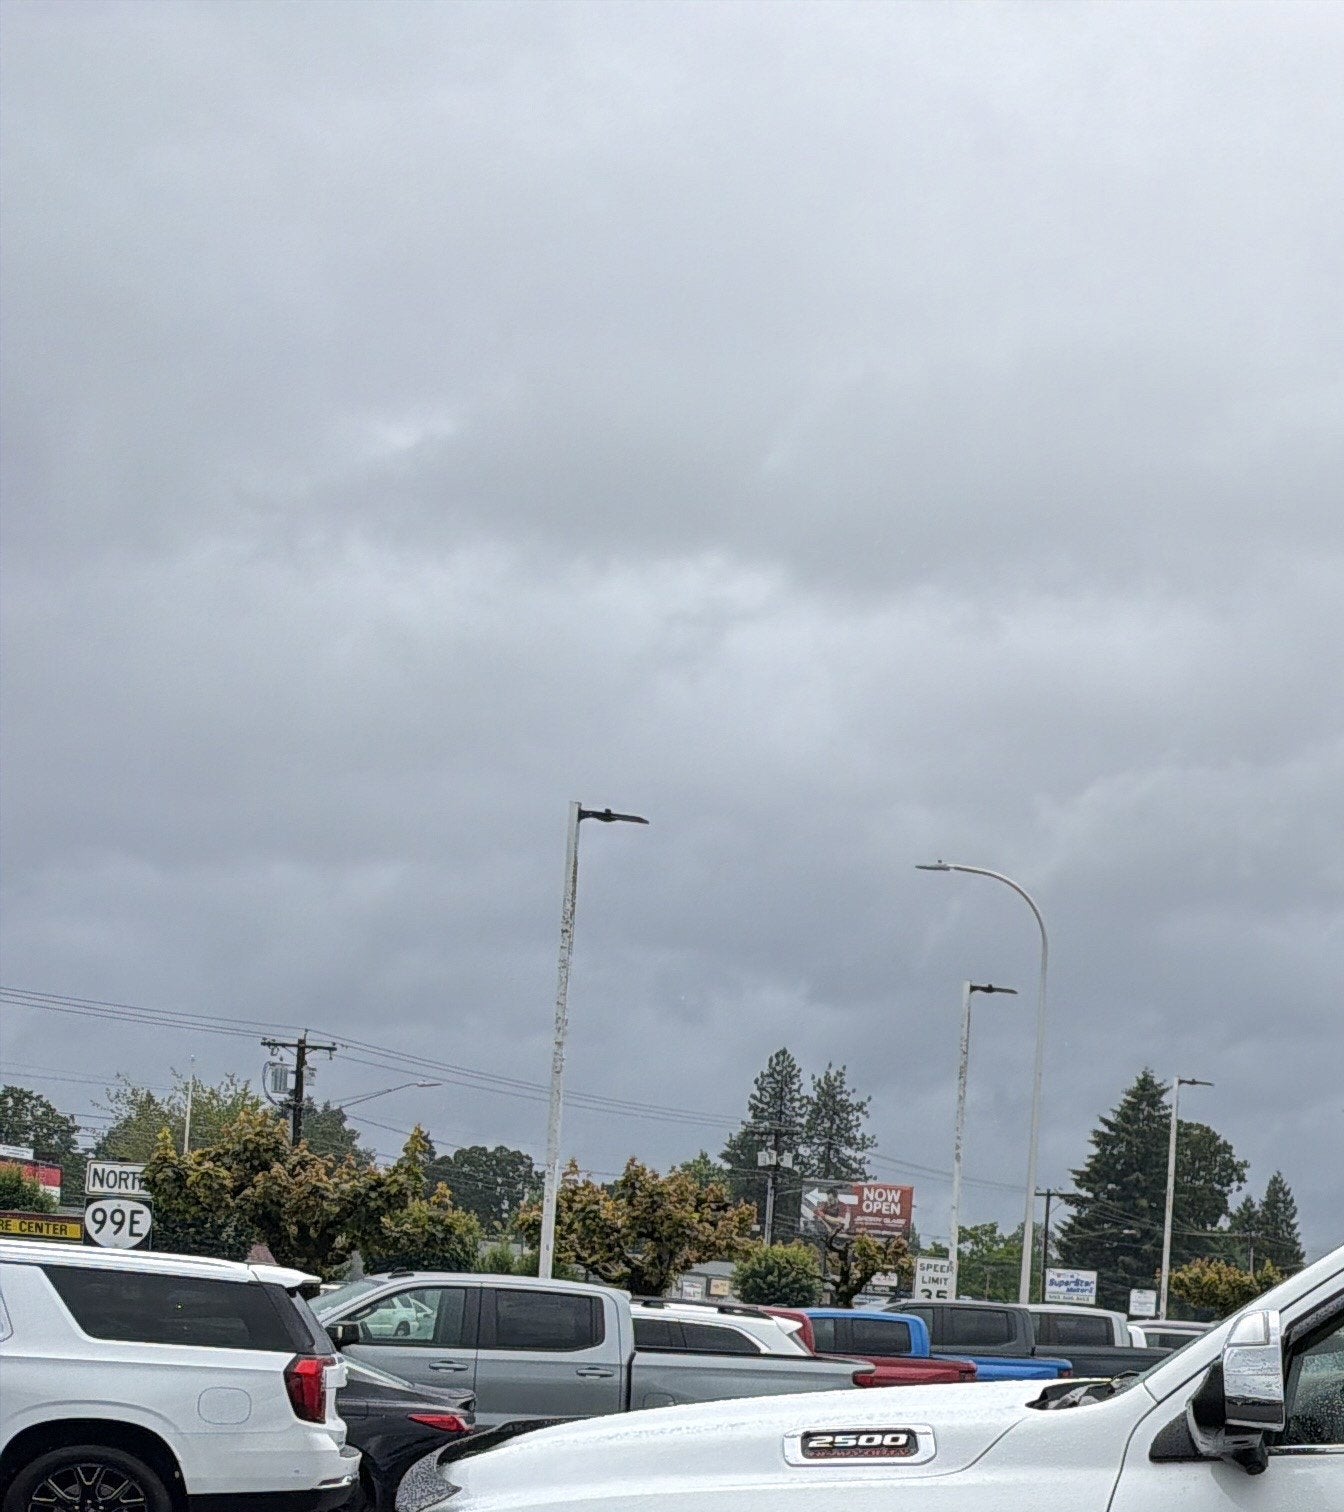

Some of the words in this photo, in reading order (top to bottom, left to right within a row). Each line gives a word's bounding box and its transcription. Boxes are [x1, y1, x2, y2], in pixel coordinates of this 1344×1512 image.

[862, 1186, 901, 1203] NOW
[862, 1200, 901, 1216] OPEN
[18, 1220, 68, 1236] CENTER
[91, 1207, 144, 1238] 99E
[921, 1275, 949, 1286] LIMIT
[808, 1434, 909, 1448] 2500
